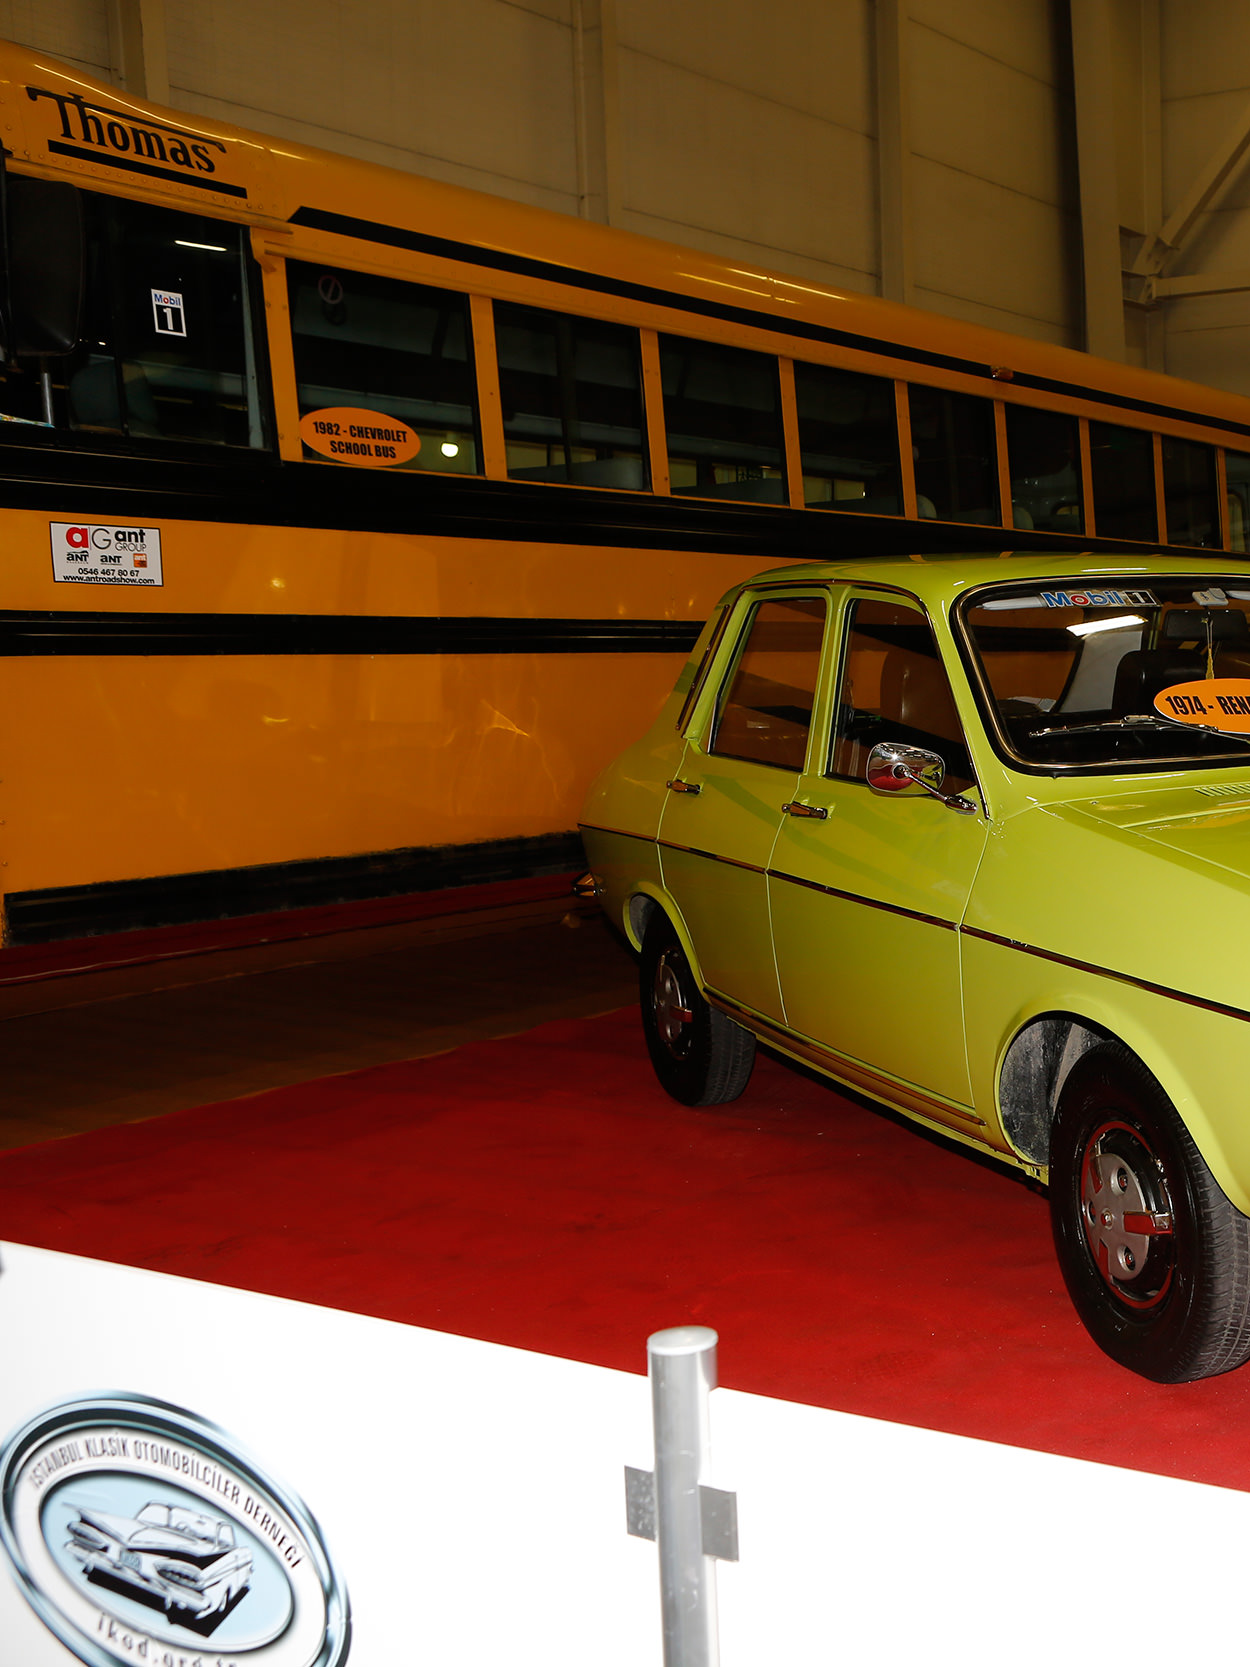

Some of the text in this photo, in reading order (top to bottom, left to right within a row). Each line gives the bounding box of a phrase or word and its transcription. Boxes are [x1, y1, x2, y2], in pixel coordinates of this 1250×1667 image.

[26, 86, 226, 173] Thomas
[154, 293, 181, 306] Mobil
[163, 307, 174, 331] 1
[313, 421, 341, 436] 1982
[349, 425, 408, 443] CHEVROLET
[330, 440, 397, 458] SCHOOL BUS
[114, 529, 146, 543] ant
[115, 542, 147, 552] GROUP
[63, 575, 155, 584] www.antroadshow.com
[78, 567, 99, 576] 0546
[101, 568, 116, 576] 467
[1040, 590, 1125, 607] Mobil
[1165, 695, 1207, 715] 1974
[85, 1431, 131, 1459] KLASİK
[133, 1439, 242, 1505] OTOMOBİLCİLER
[243, 1495, 306, 1570] DERNEĞİ
